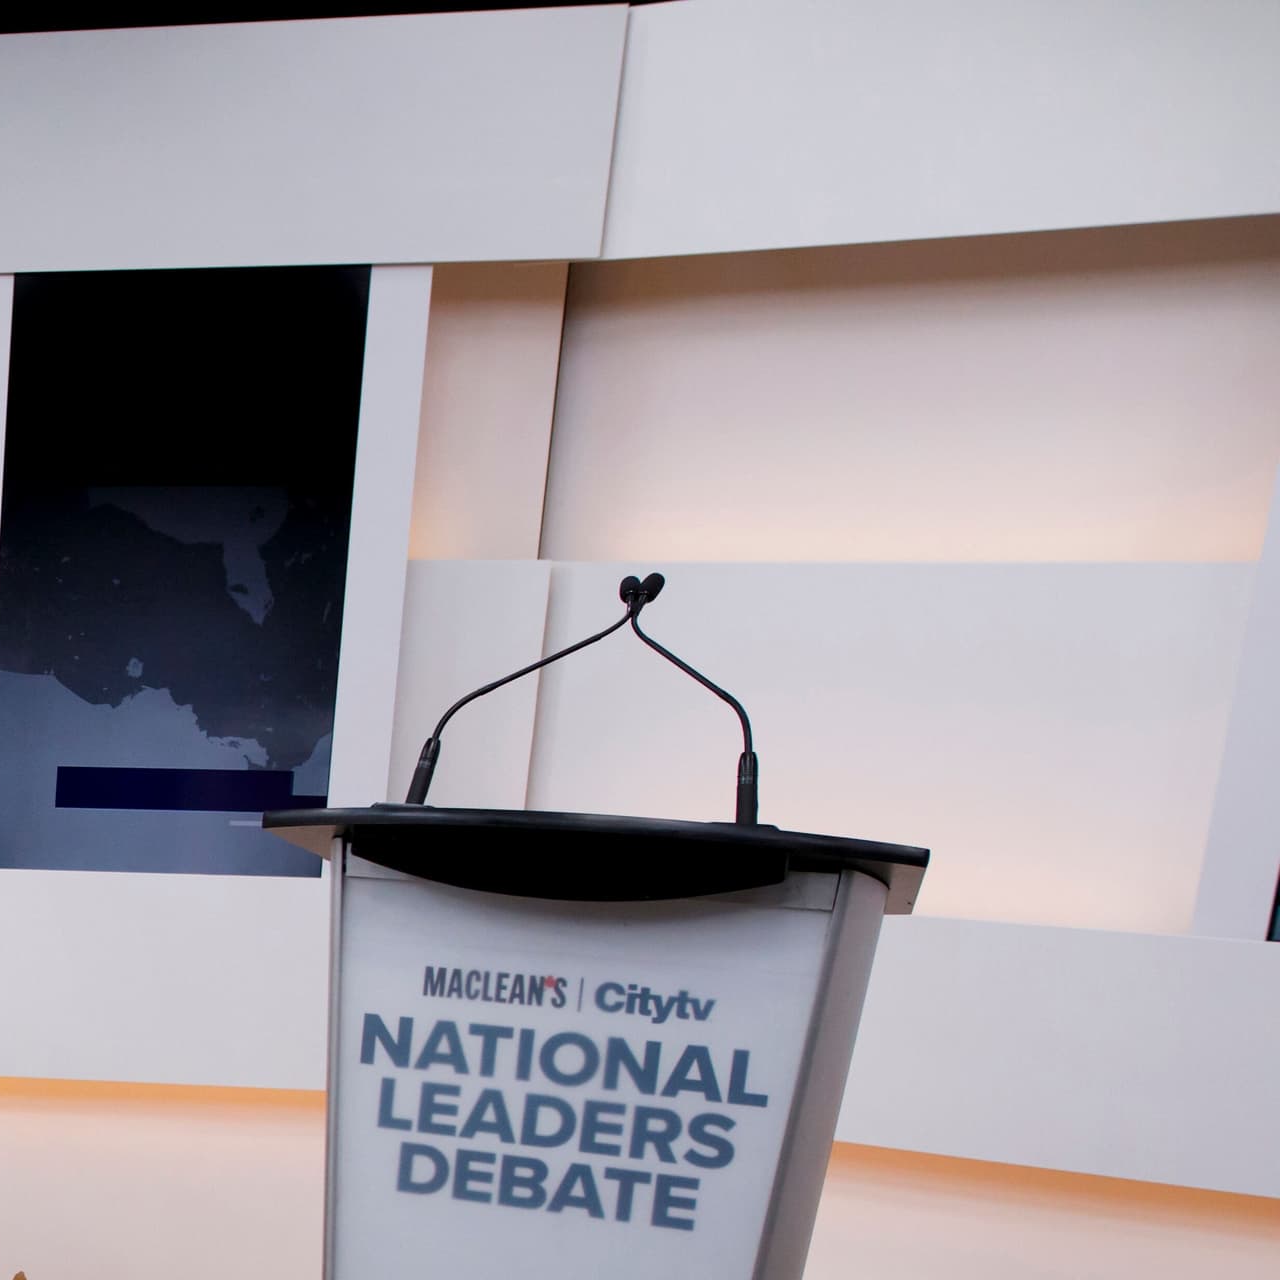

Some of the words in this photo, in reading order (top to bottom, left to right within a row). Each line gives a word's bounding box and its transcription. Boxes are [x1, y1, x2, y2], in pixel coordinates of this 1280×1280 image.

[594, 981, 717, 1024] Citytv
[359, 1013, 769, 1108] NATIONAL
[376, 1077, 737, 1170] LEADERS
[396, 1142, 701, 1232] DEBATE
